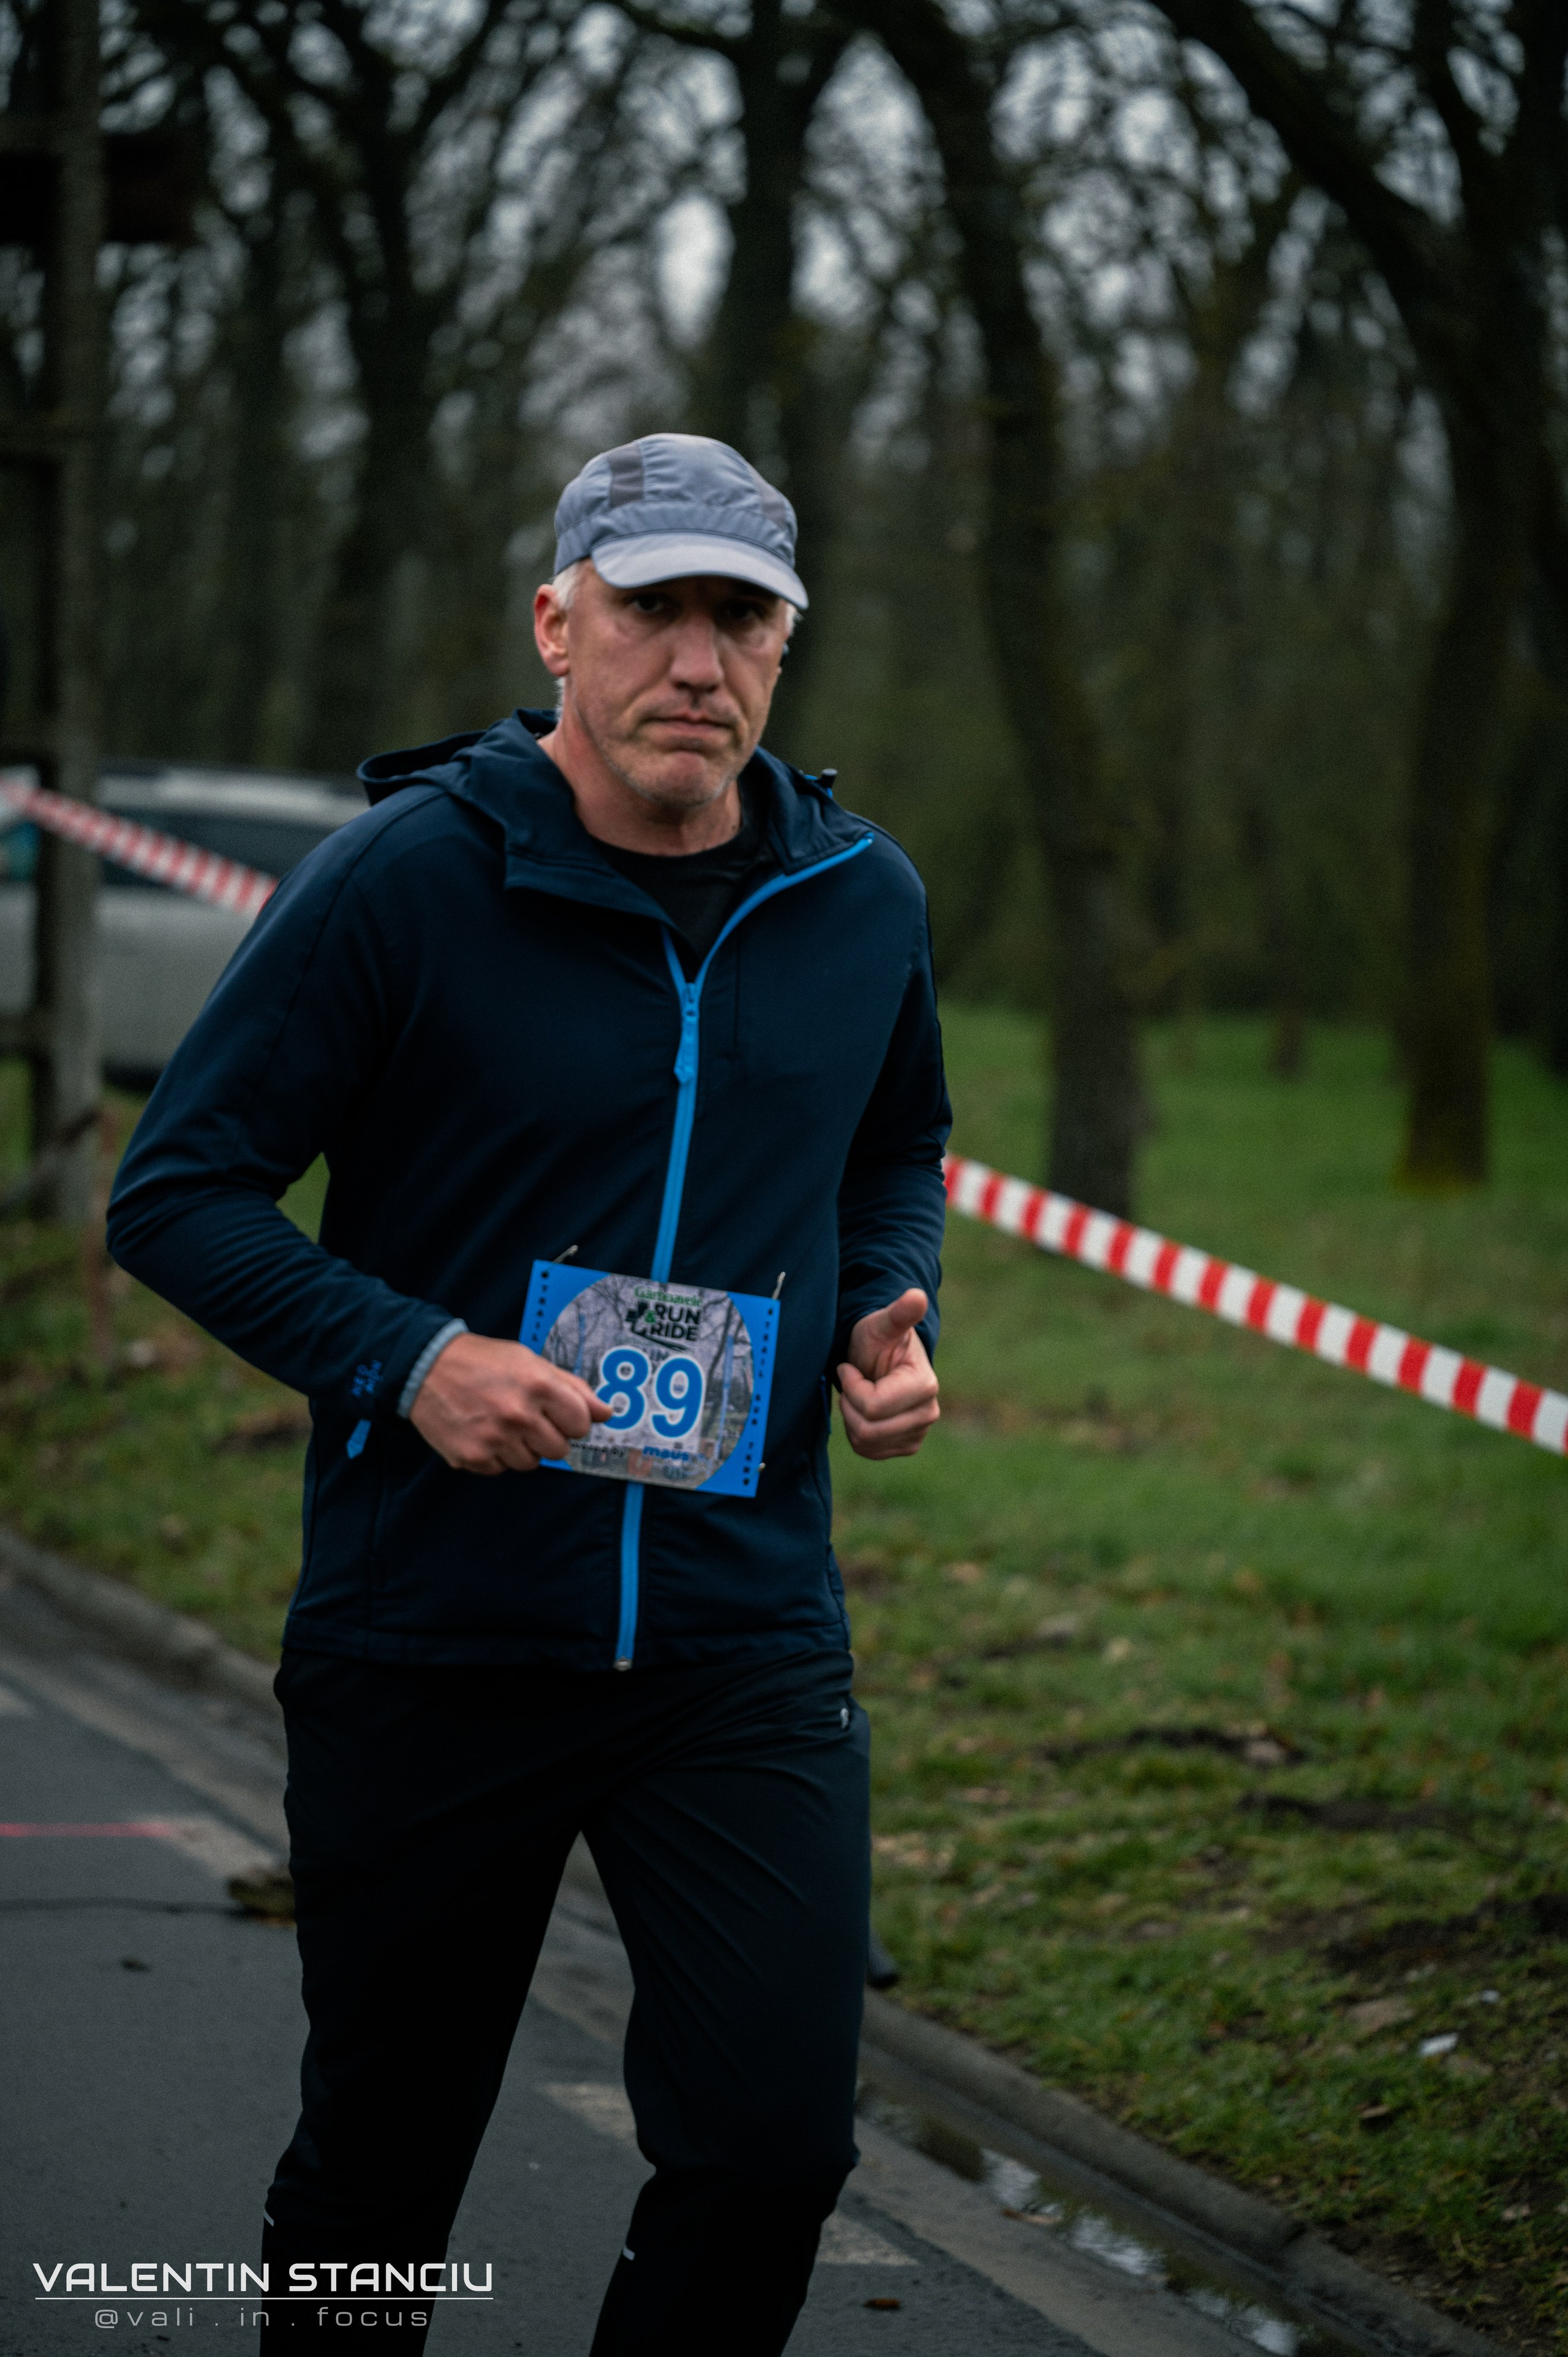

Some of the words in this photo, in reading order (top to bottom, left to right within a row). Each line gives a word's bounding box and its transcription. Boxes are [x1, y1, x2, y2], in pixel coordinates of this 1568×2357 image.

[645, 1310, 656, 1324] &
[655, 1302, 700, 1325] RUN
[650, 1321, 698, 1341] RIDE
[597, 1349, 703, 1438] 89
